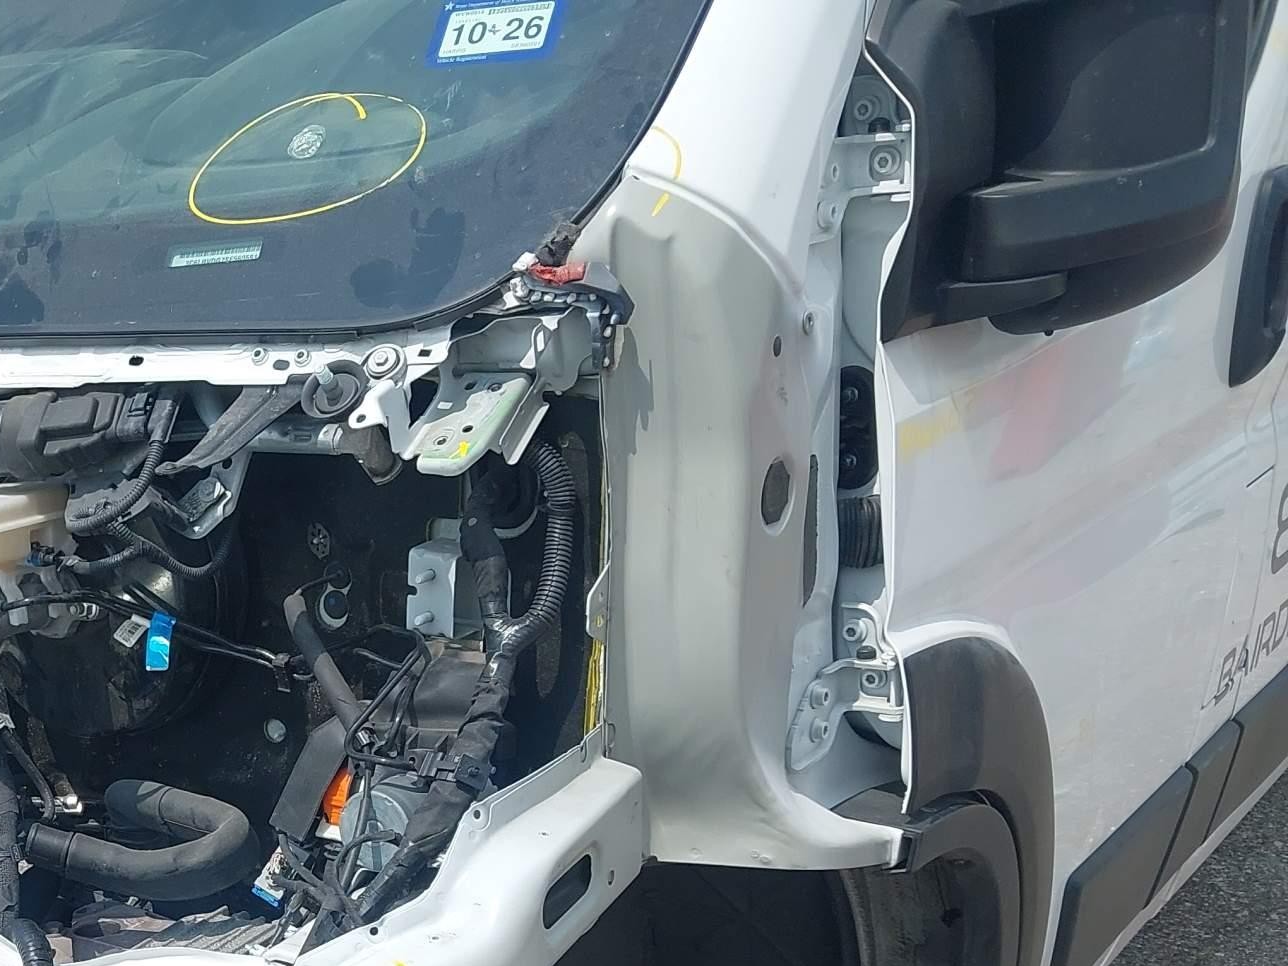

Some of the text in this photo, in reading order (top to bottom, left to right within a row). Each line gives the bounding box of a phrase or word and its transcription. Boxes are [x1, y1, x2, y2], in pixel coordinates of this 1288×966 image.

[452, 15, 544, 46] 10 26
[1201, 598, 1288, 709] BAIRD
